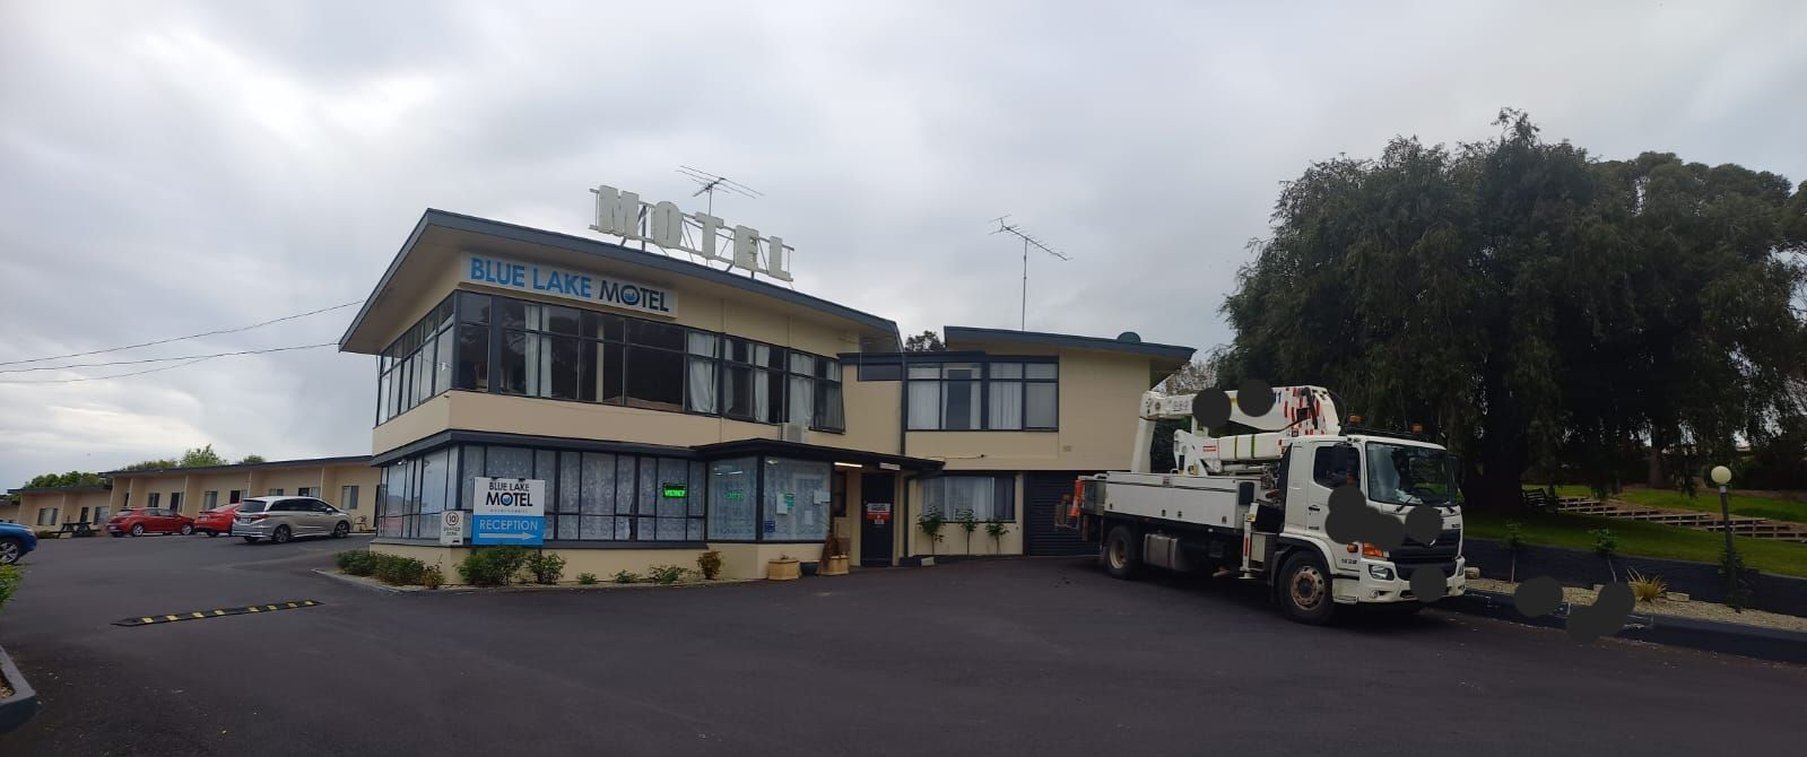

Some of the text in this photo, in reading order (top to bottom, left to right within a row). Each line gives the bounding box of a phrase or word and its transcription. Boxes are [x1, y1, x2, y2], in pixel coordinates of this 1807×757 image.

[599, 185, 794, 282] MOTEL
[470, 257, 670, 313] BLUE LAKE MOTEL
[489, 481, 530, 492] BLUE LAKE
[485, 491, 533, 507] MOTEL
[479, 519, 538, 531] RECEPTION
